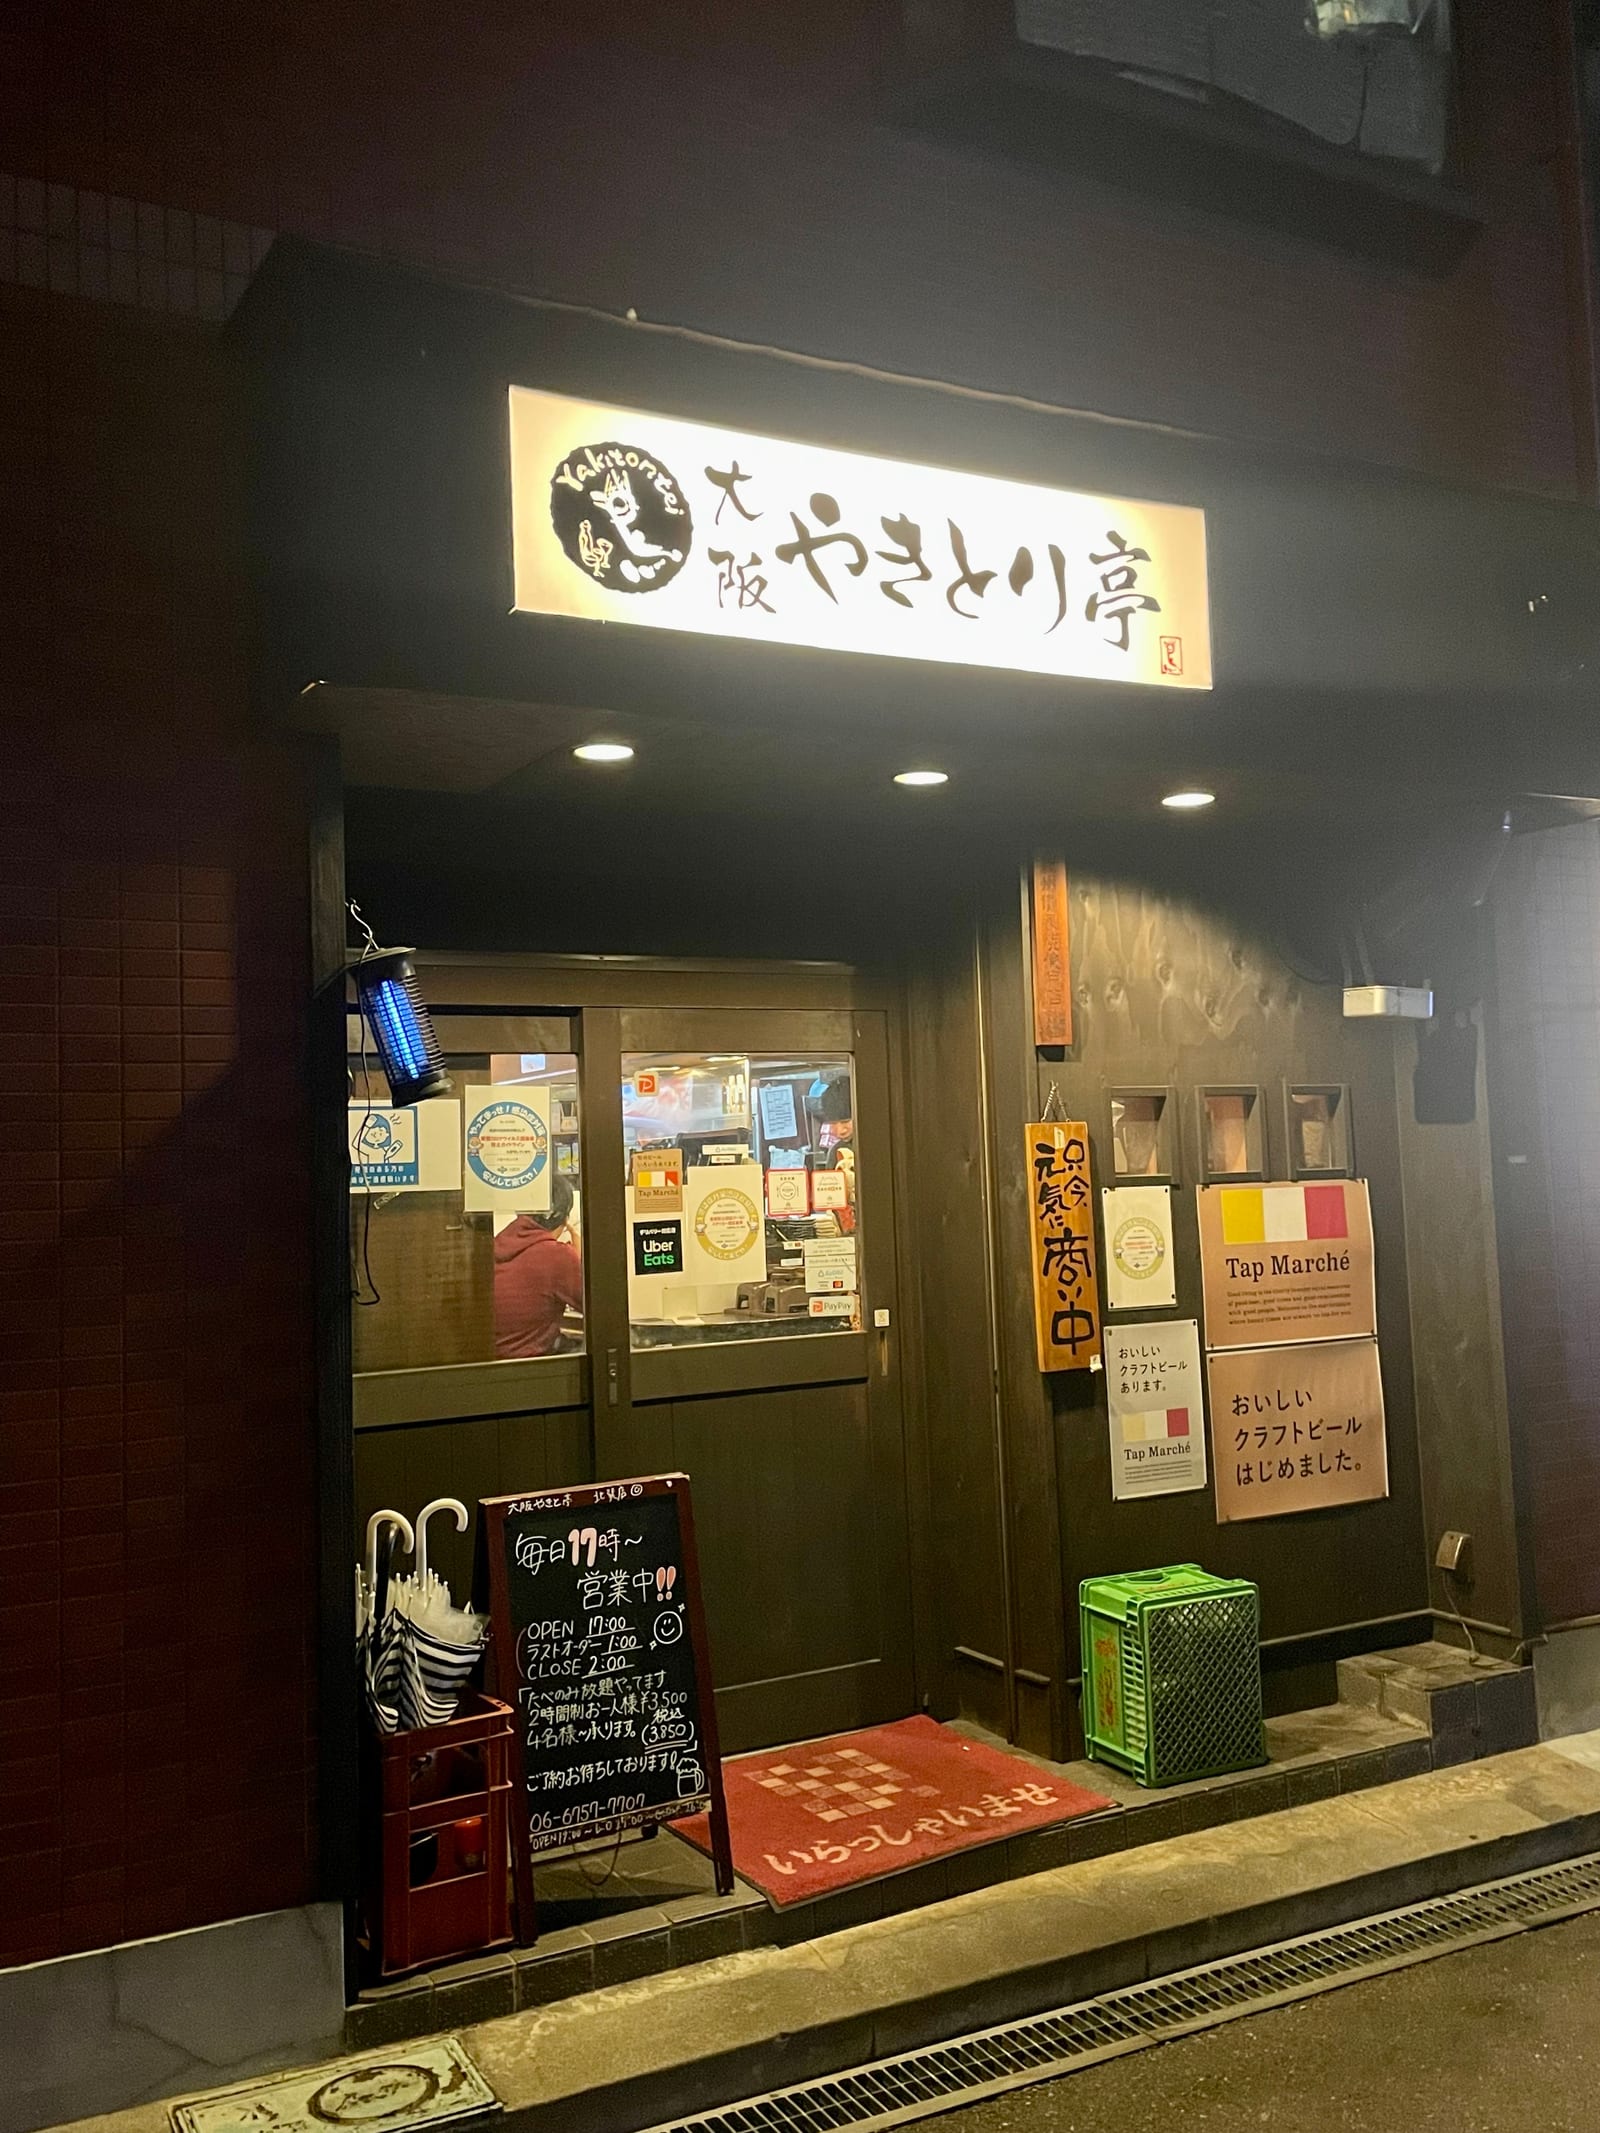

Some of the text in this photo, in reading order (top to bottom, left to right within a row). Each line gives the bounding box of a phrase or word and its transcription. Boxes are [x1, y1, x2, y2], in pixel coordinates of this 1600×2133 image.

[704, 460, 776, 614] 大阪
[775, 492, 1161, 652] やきとり亭
[643, 1240, 674, 1252] Uber
[644, 1253, 675, 1266] Eats
[1225, 1249, 1351, 1283] Tap Marché
[824, 1302, 852, 1311] PayPay
[1118, 1346, 1161, 1359] おいしい
[1120, 1360, 1188, 1377] クラフトビール
[1120, 1379, 1167, 1394] あります。
[1232, 1389, 1313, 1416] おいしい
[1235, 1416, 1362, 1452] クラフトビール
[1124, 1442, 1191, 1461] Tap Marché
[1236, 1448, 1362, 1486] はじめました。
[527, 1615, 627, 1640] OPEN 17:00
[527, 1635, 638, 1662] ラストオーダー 1:00
[527, 1655, 627, 1680] CLOSE 2:00
[651, 1707, 685, 1725] 税込
[529, 1793, 645, 1833] 06-6757-7707
[764, 1783, 1058, 1875] いらっしゃいませ
